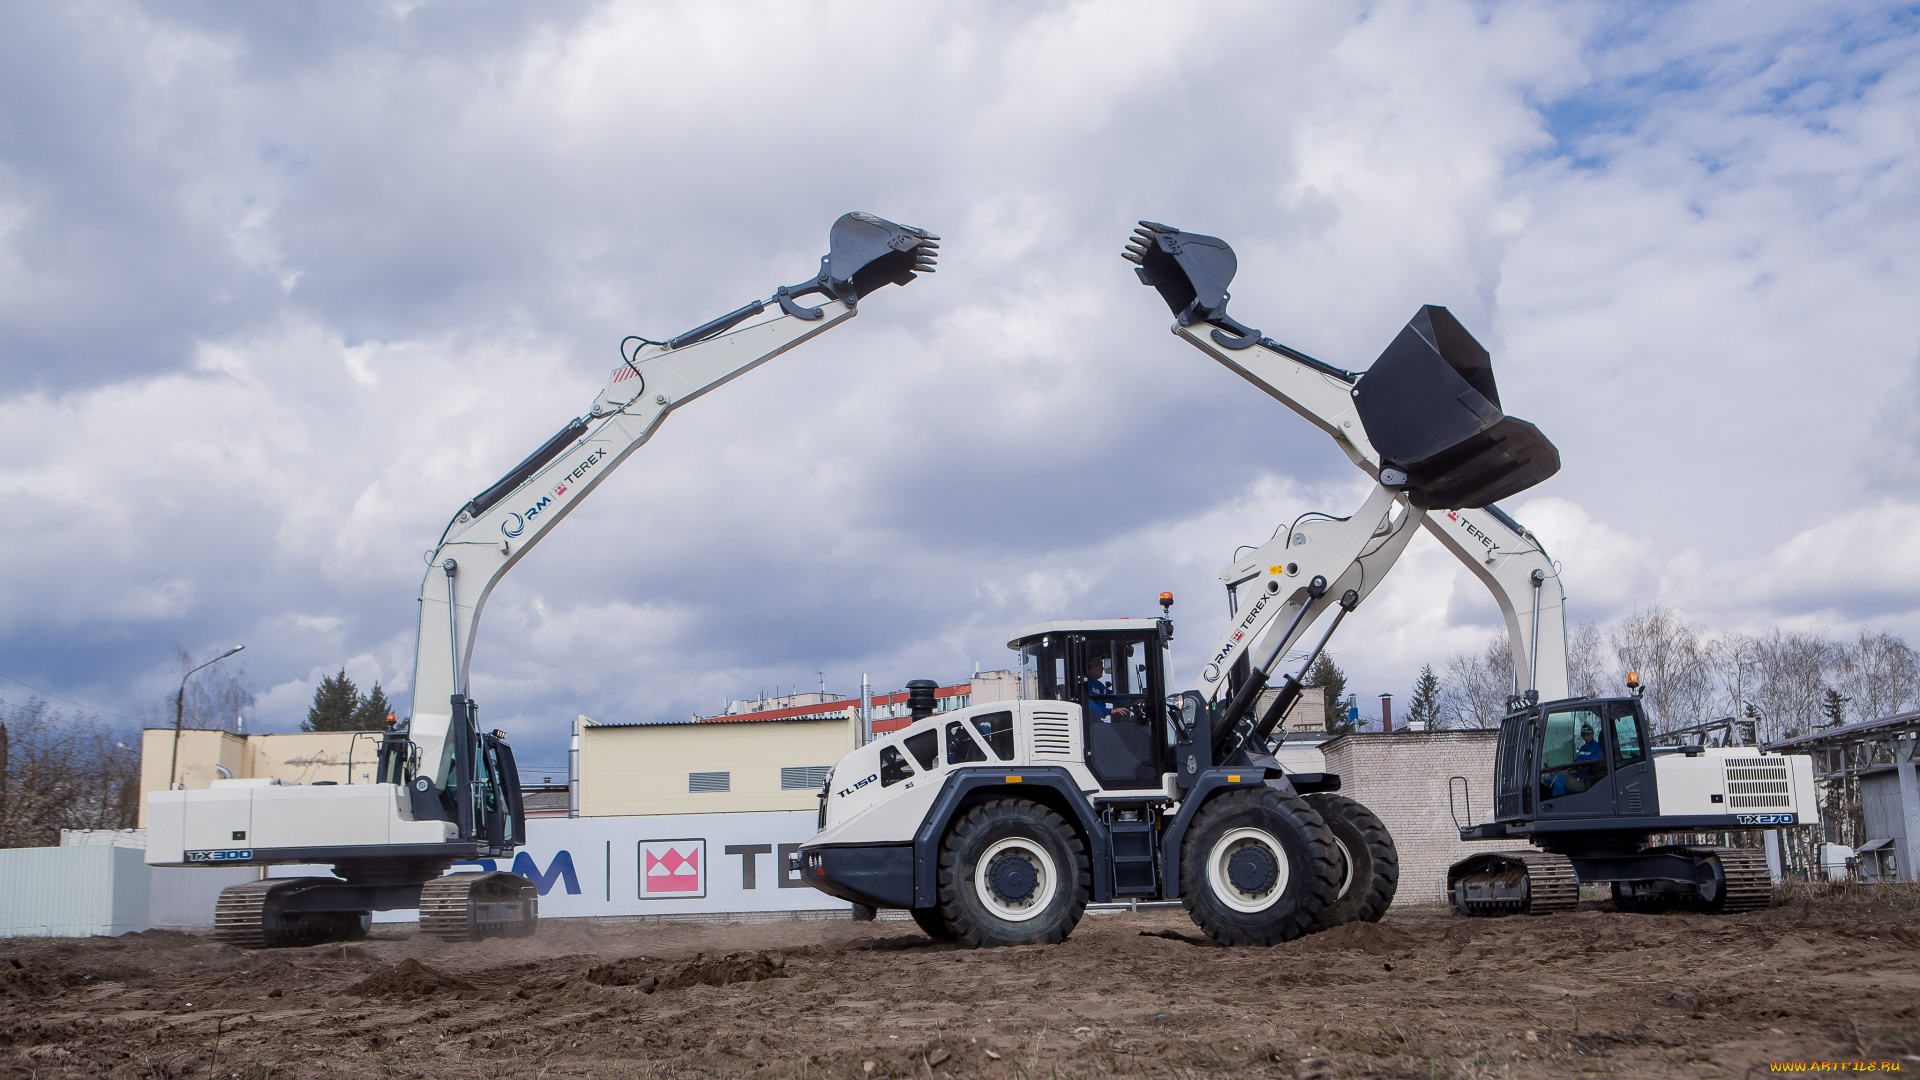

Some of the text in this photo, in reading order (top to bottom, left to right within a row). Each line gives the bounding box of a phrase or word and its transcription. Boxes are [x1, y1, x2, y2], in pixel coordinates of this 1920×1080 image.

[524, 496, 551, 520] RM
[564, 447, 607, 483] TEREX
[1215, 643, 1233, 664] RM
[1240, 593, 1270, 629] TEREX
[1737, 814, 1793, 824] TX270
[188, 850, 253, 861] TX300
[440, 850, 582, 896] M
